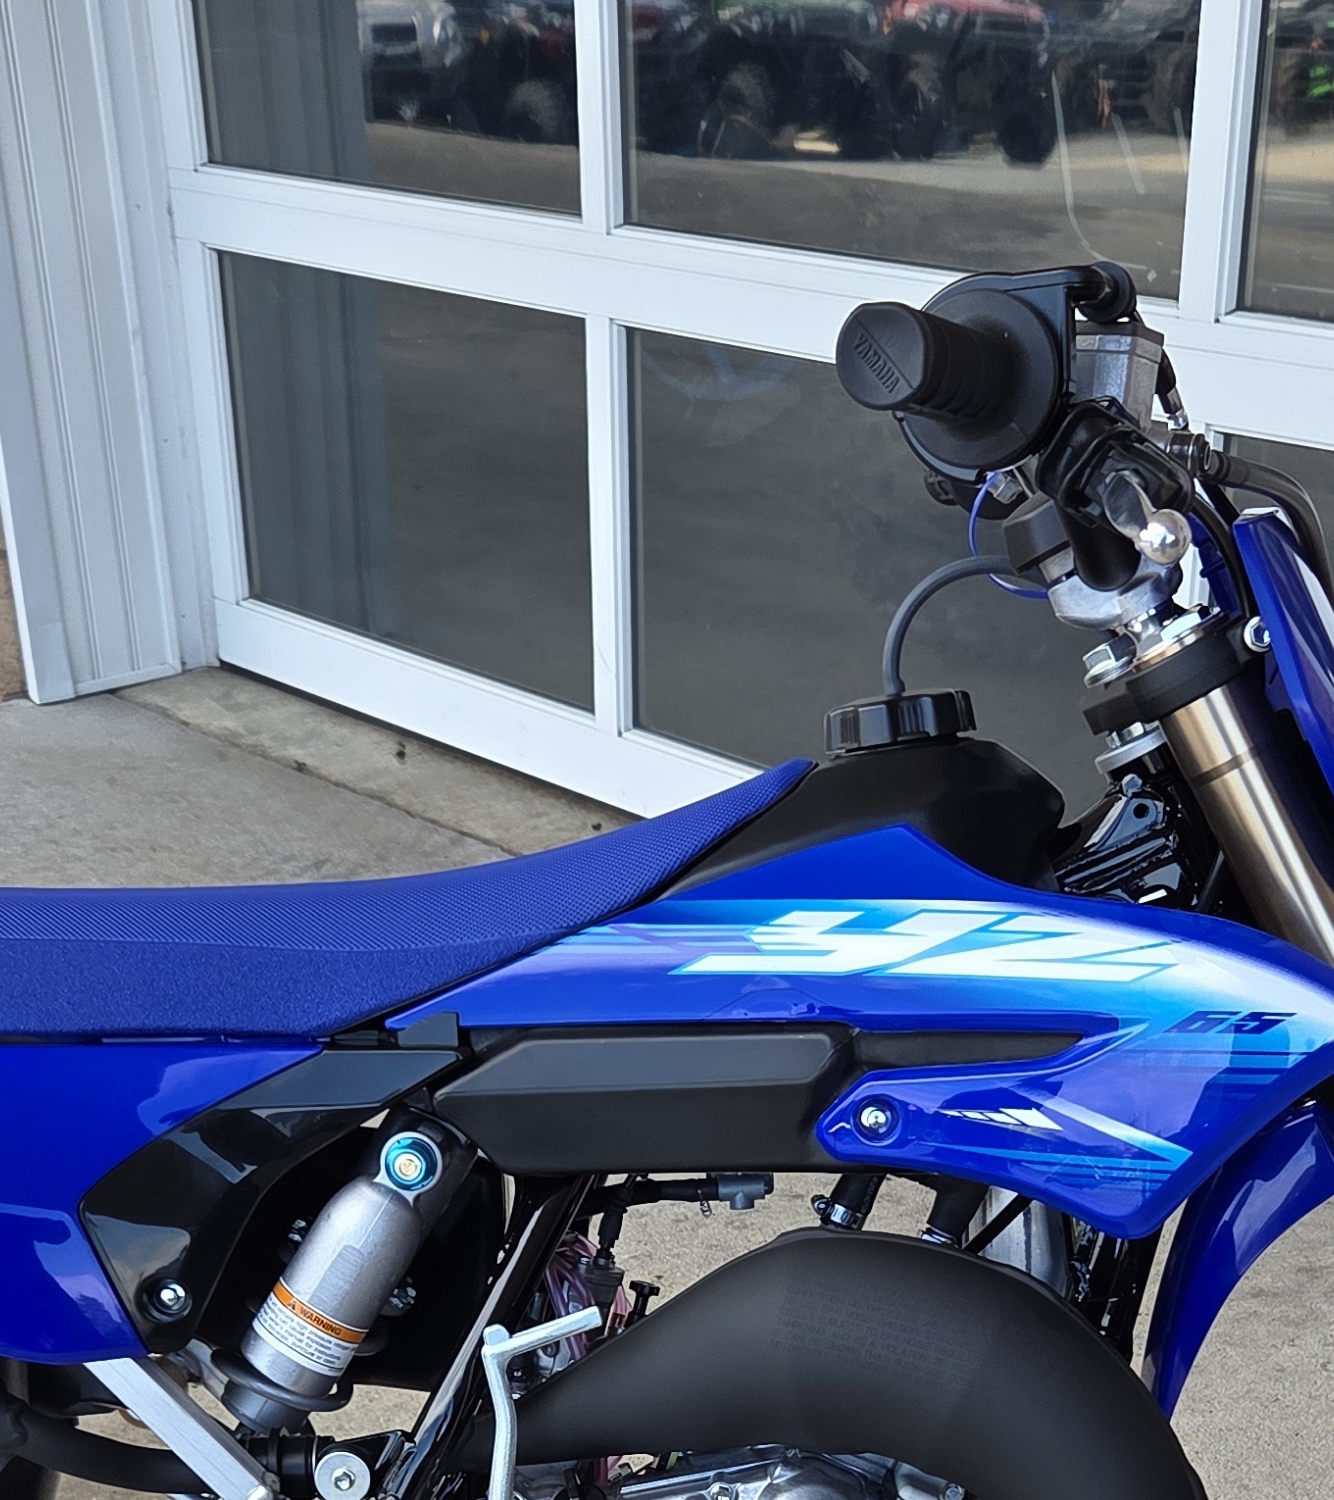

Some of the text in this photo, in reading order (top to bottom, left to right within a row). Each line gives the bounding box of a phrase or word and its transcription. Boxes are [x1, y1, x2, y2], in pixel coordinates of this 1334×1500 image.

[854, 333, 901, 394] YAMAHA
[669, 909, 1178, 983] YZ
[1164, 1010, 1299, 1035] 65
[300, 1306, 343, 1336] WARNING
